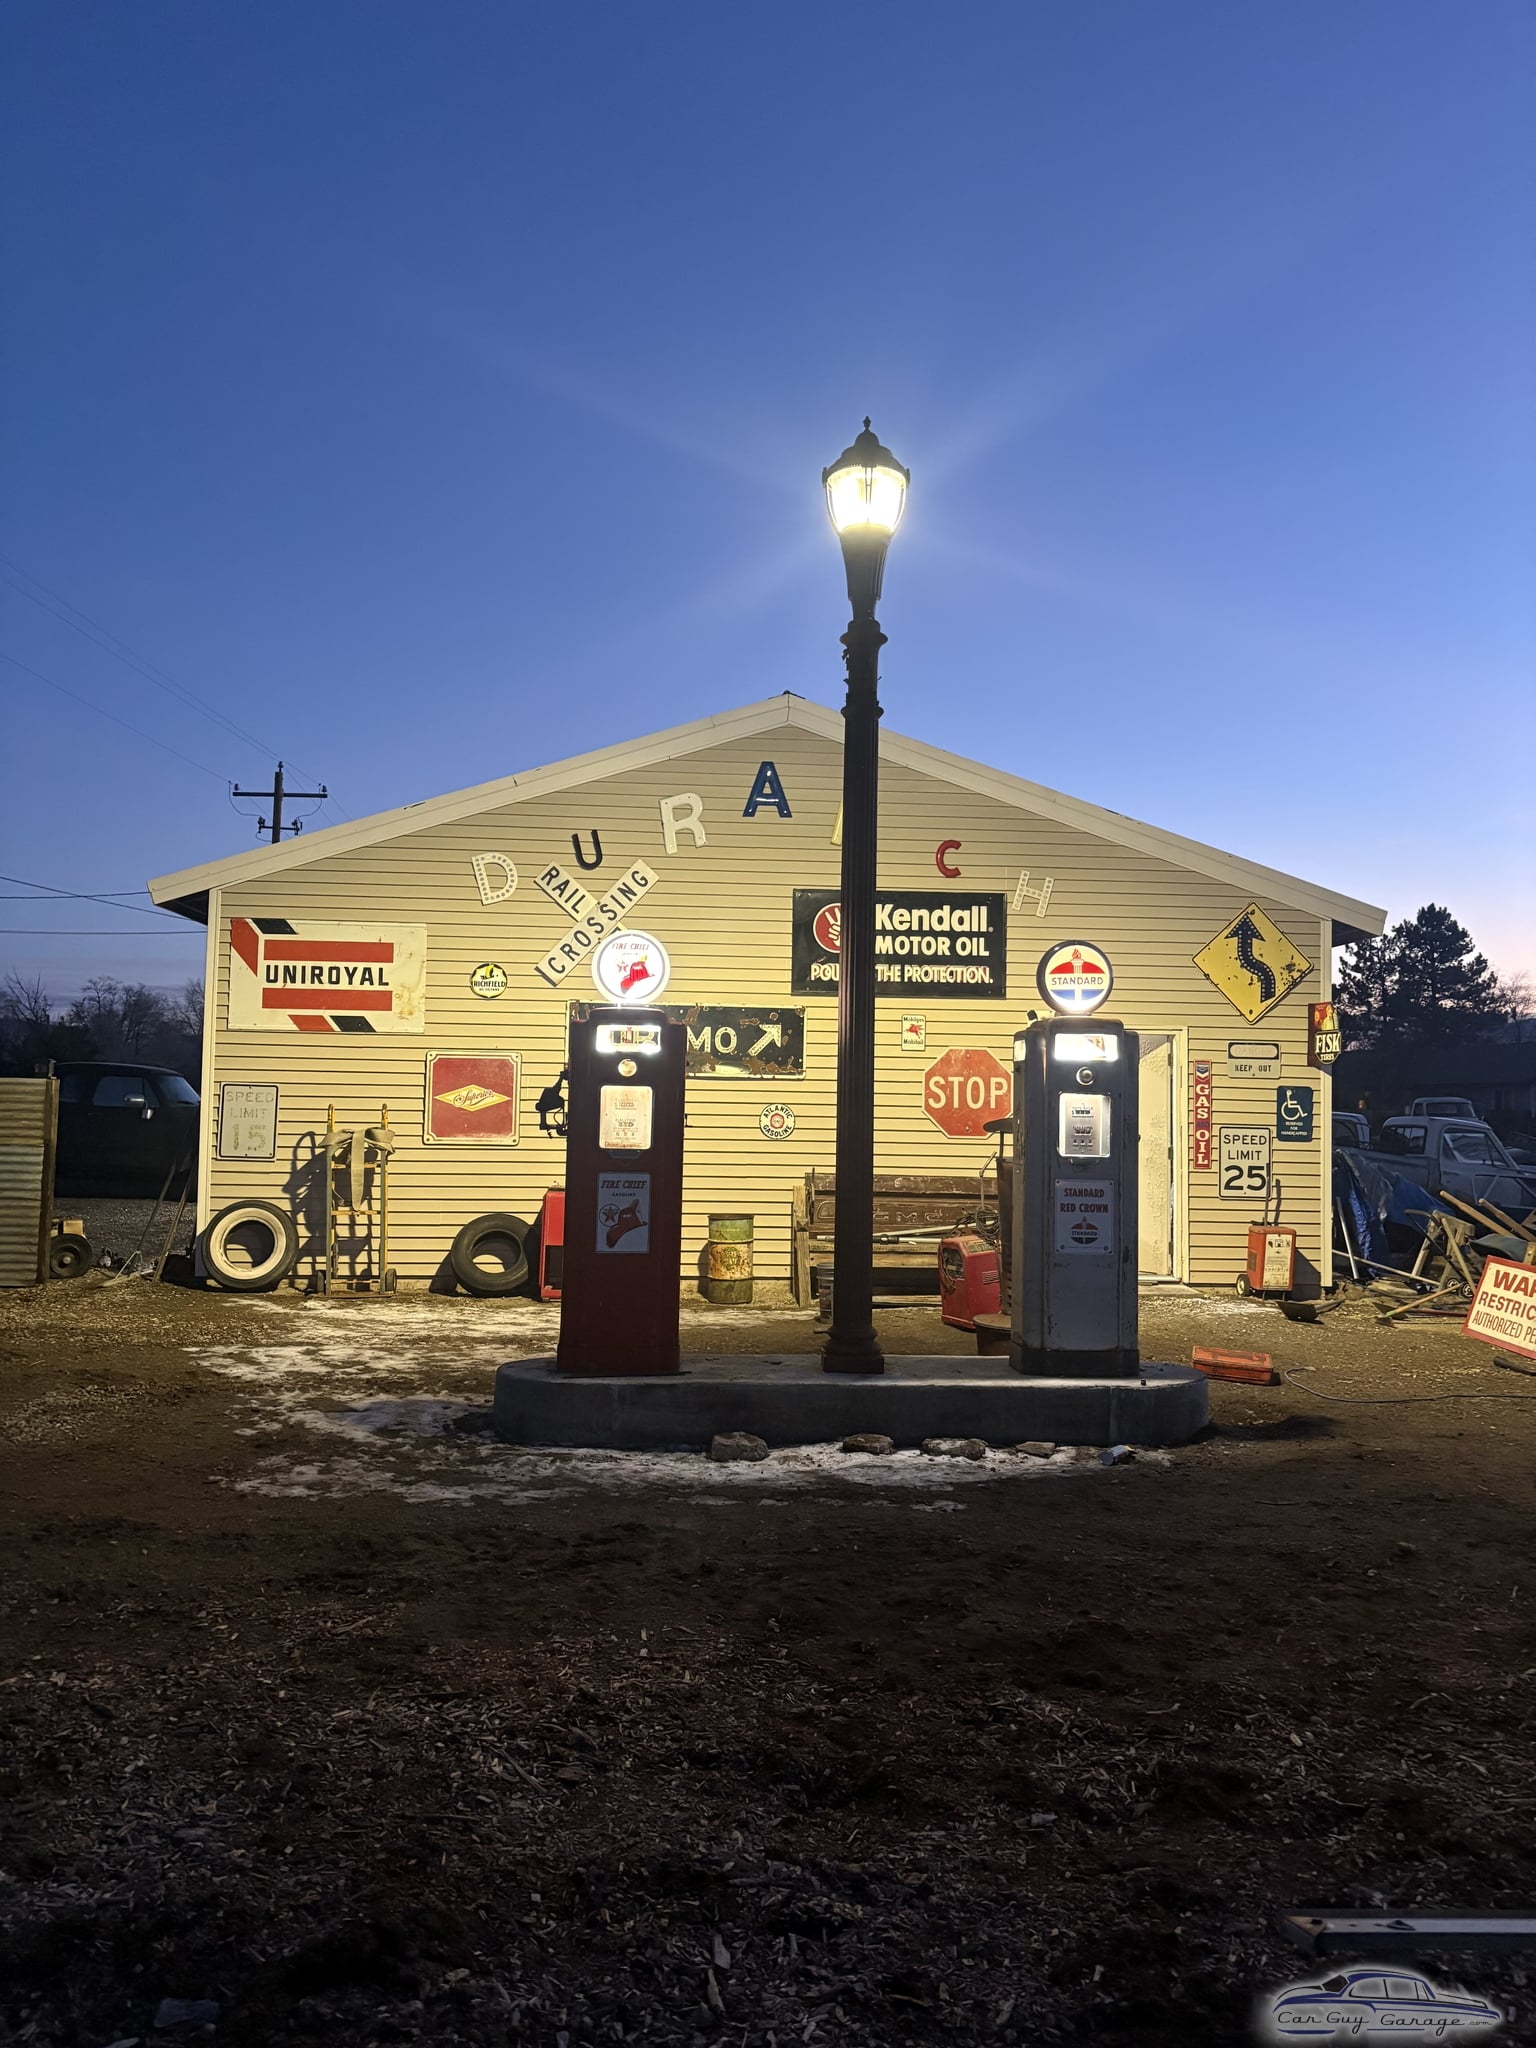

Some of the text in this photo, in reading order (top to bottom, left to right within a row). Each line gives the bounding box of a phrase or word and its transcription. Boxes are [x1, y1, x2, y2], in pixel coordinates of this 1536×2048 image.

[540, 866, 586, 914] RAIL
[547, 870, 649, 974] CROSSING
[875, 903, 988, 932] Kendall
[875, 935, 990, 957] MOTOR OIL
[265, 964, 390, 987] UNIROYAL
[874, 963, 901, 982] THE
[1051, 976, 1104, 985] STANDARD
[473, 980, 506, 988] RICHFIELD
[1316, 1033, 1341, 1053] FISK
[1234, 1064, 1272, 1072] KEEP OUT
[225, 1091, 275, 1103] SPEED
[927, 1075, 1008, 1110] STOP
[1195, 1083, 1210, 1119] GAS
[763, 1105, 793, 1119] ATLANTIC
[763, 1124, 792, 1138] GASOLINE
[1223, 1134, 1267, 1146] SPEED
[1195, 1129, 1210, 1165] OIL
[1228, 1149, 1262, 1161] LIMIT
[600, 1180, 647, 1189] FIRE CHIEF
[1223, 1164, 1267, 1192] 25
[1064, 1187, 1105, 1198] STANDARD
[1060, 1202, 1109, 1214] RED CROWN
[1472, 1310, 1523, 1339] AUTHORIZED
